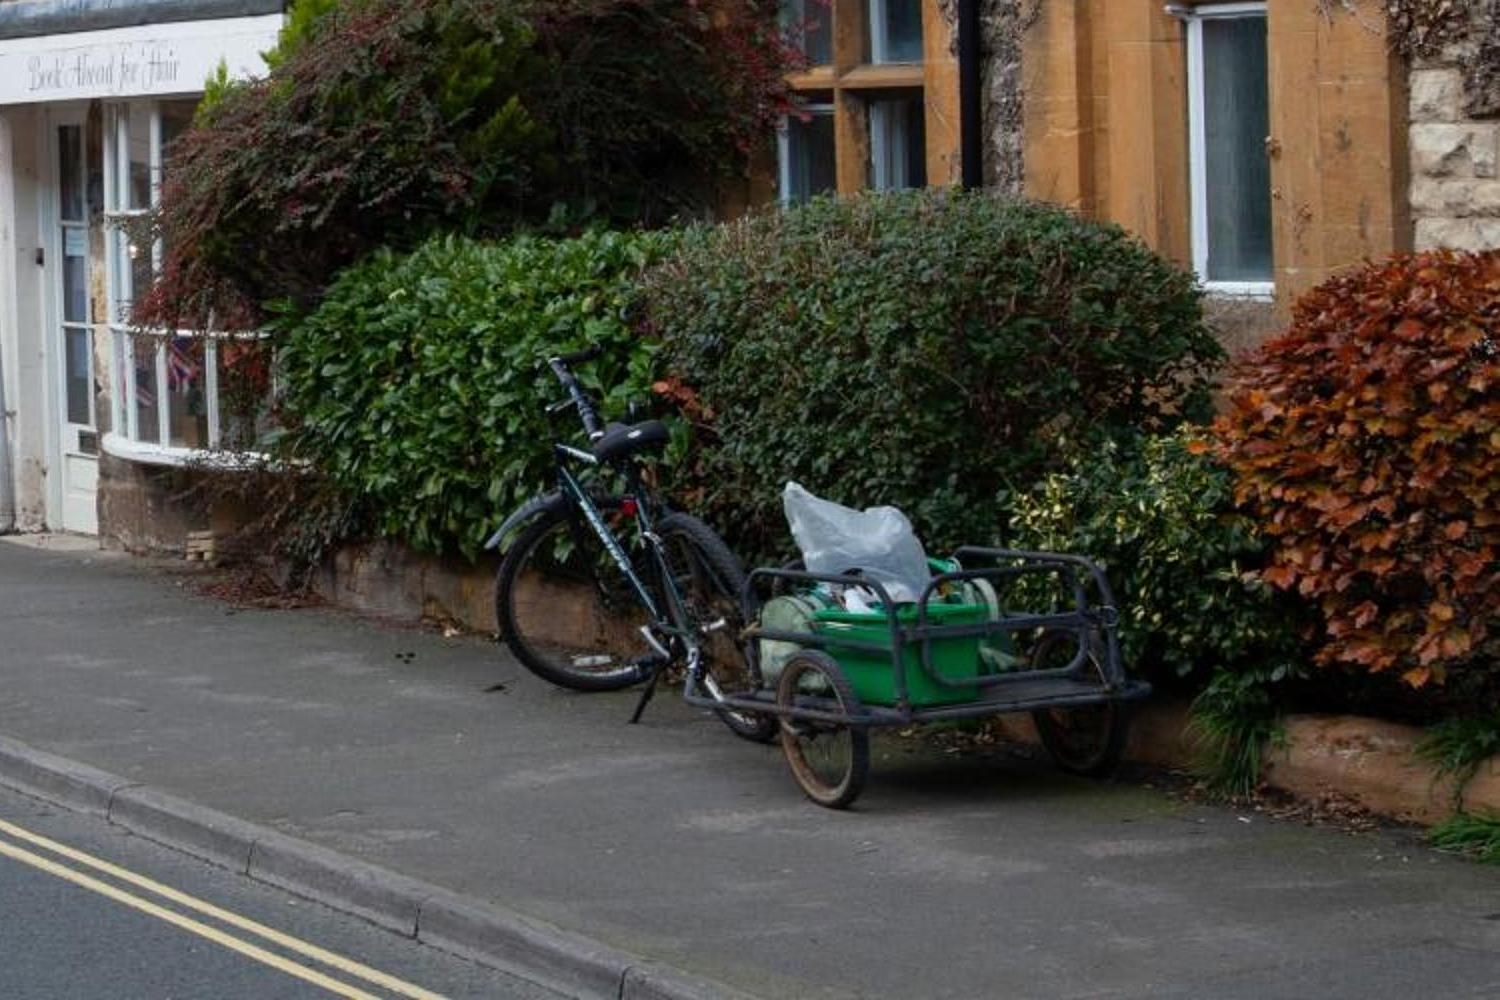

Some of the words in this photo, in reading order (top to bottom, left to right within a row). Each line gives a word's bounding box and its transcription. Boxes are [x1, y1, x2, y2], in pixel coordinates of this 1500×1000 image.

[27, 55, 62, 91] Book
[64, 53, 115, 89] Ahead
[141, 47, 180, 90] Hair
